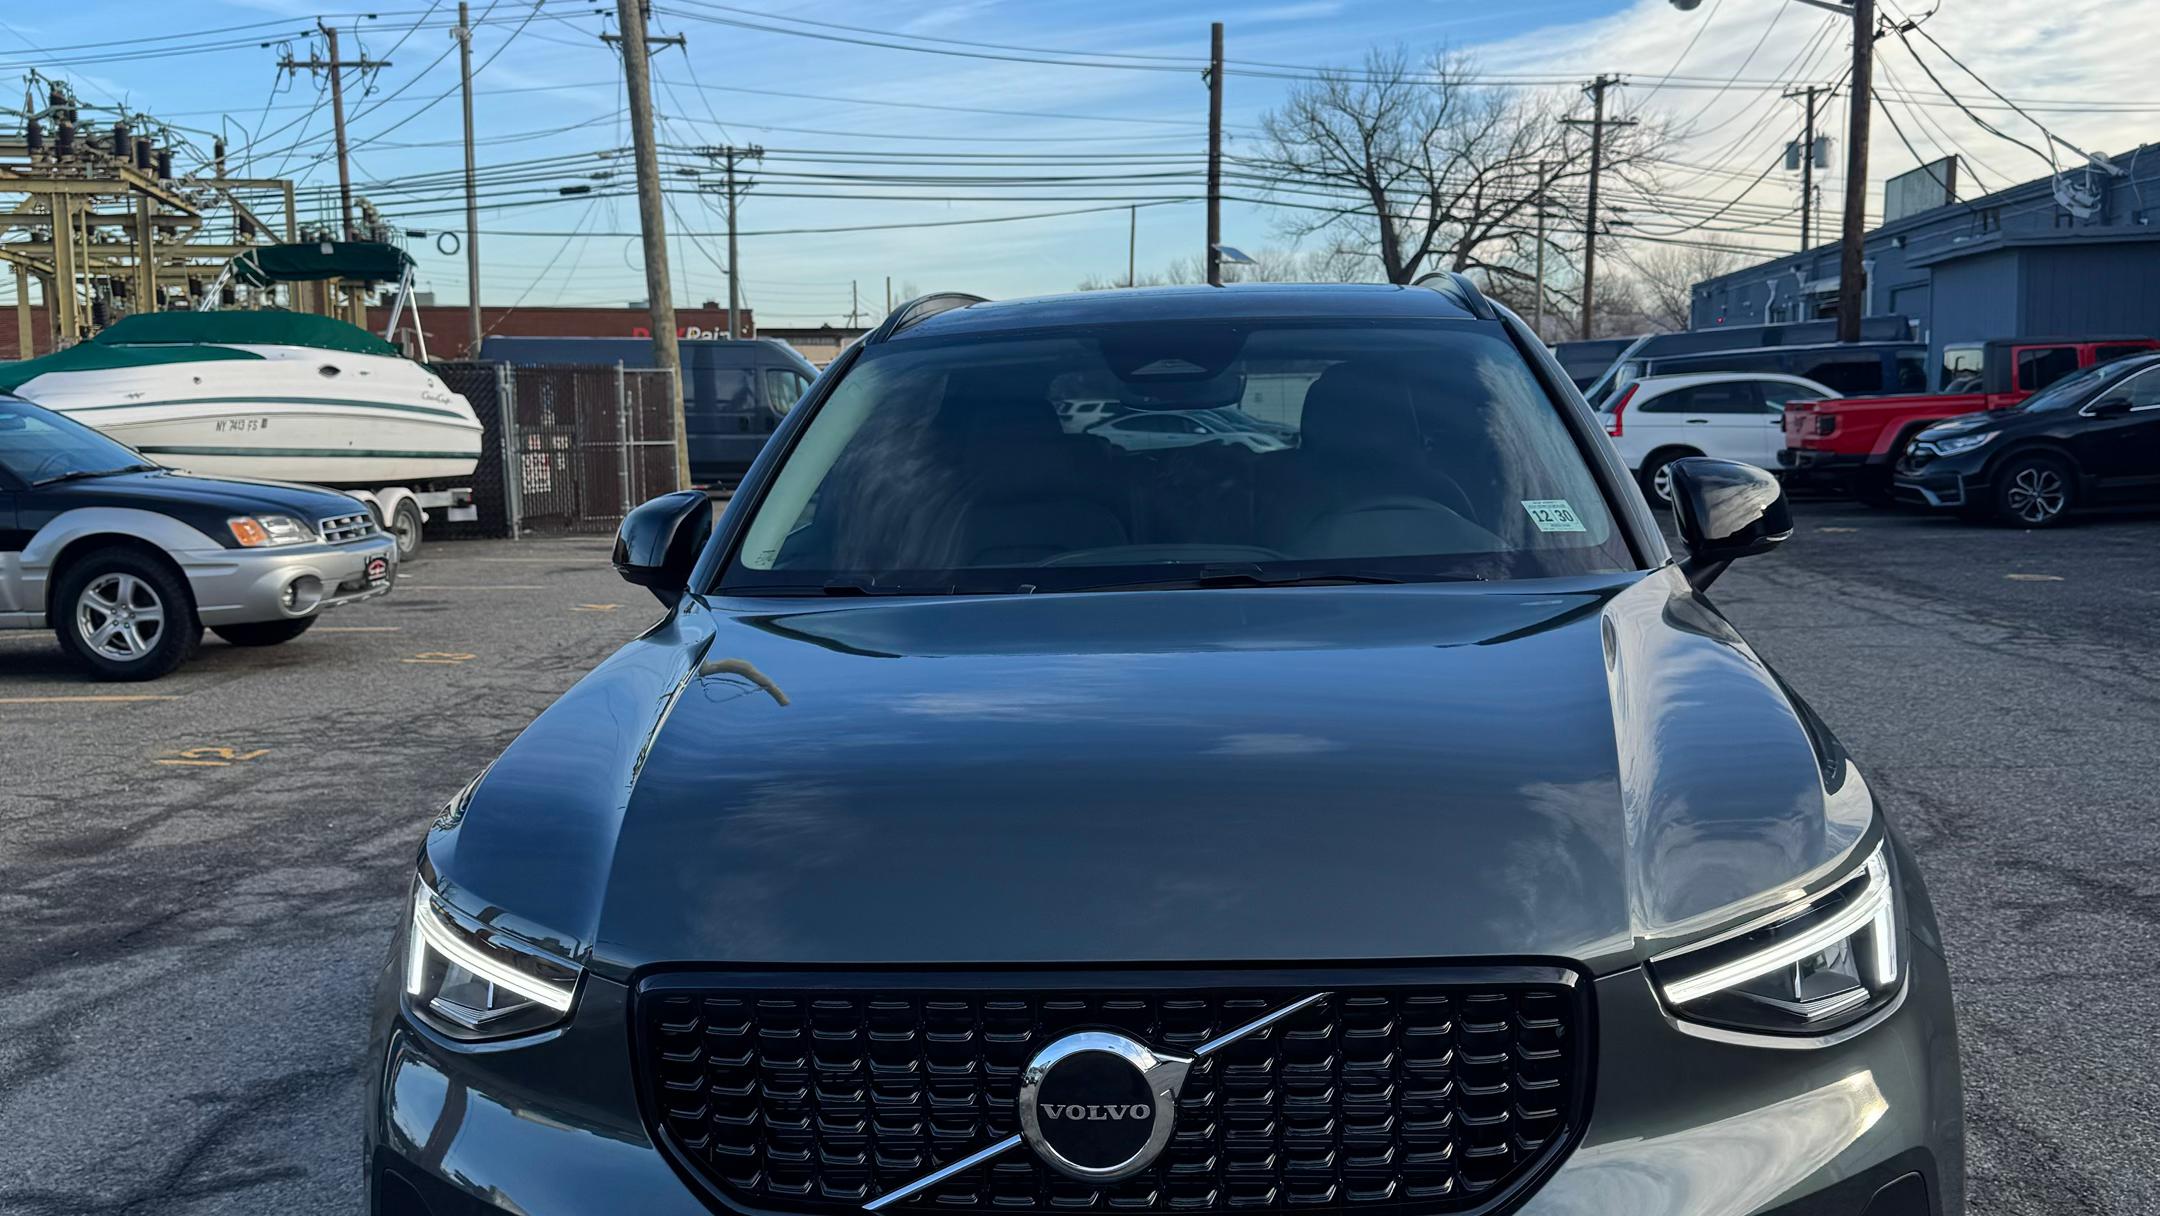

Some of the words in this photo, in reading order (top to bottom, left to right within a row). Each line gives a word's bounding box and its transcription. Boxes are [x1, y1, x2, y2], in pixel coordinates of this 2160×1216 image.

[686, 326, 732, 340] Pain
[215, 419, 227, 432] NY
[1532, 509, 1554, 522] 12
[1554, 509, 1574, 522] 30
[1040, 1103, 1151, 1120] VOLVO
